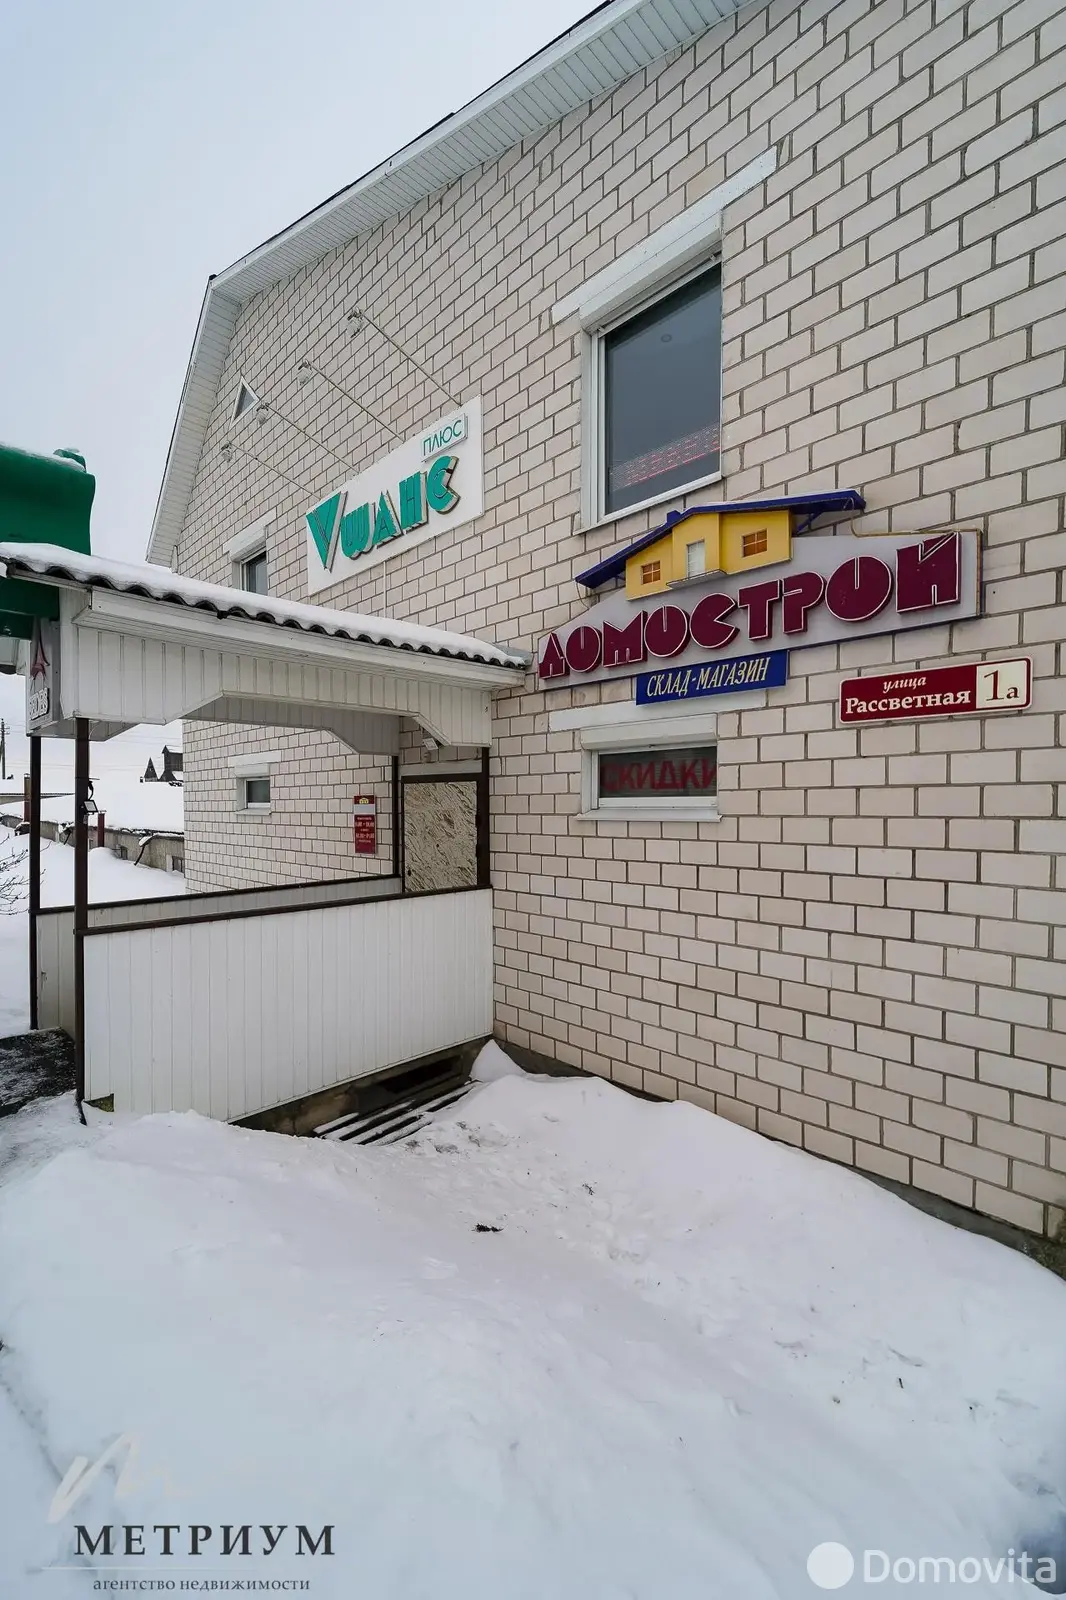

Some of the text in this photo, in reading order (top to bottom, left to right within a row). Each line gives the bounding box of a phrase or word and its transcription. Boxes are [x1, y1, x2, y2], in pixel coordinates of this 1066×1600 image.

[423, 419, 462, 456] ПЛЮС
[538, 532, 961, 680] ДОМОСТРОЙ
[646, 656, 771, 698] СКЛАД-МАГАЗИН
[882, 676, 927, 694] улица
[983, 669, 1020, 702] 1а
[845, 690, 971, 714] Рассветная
